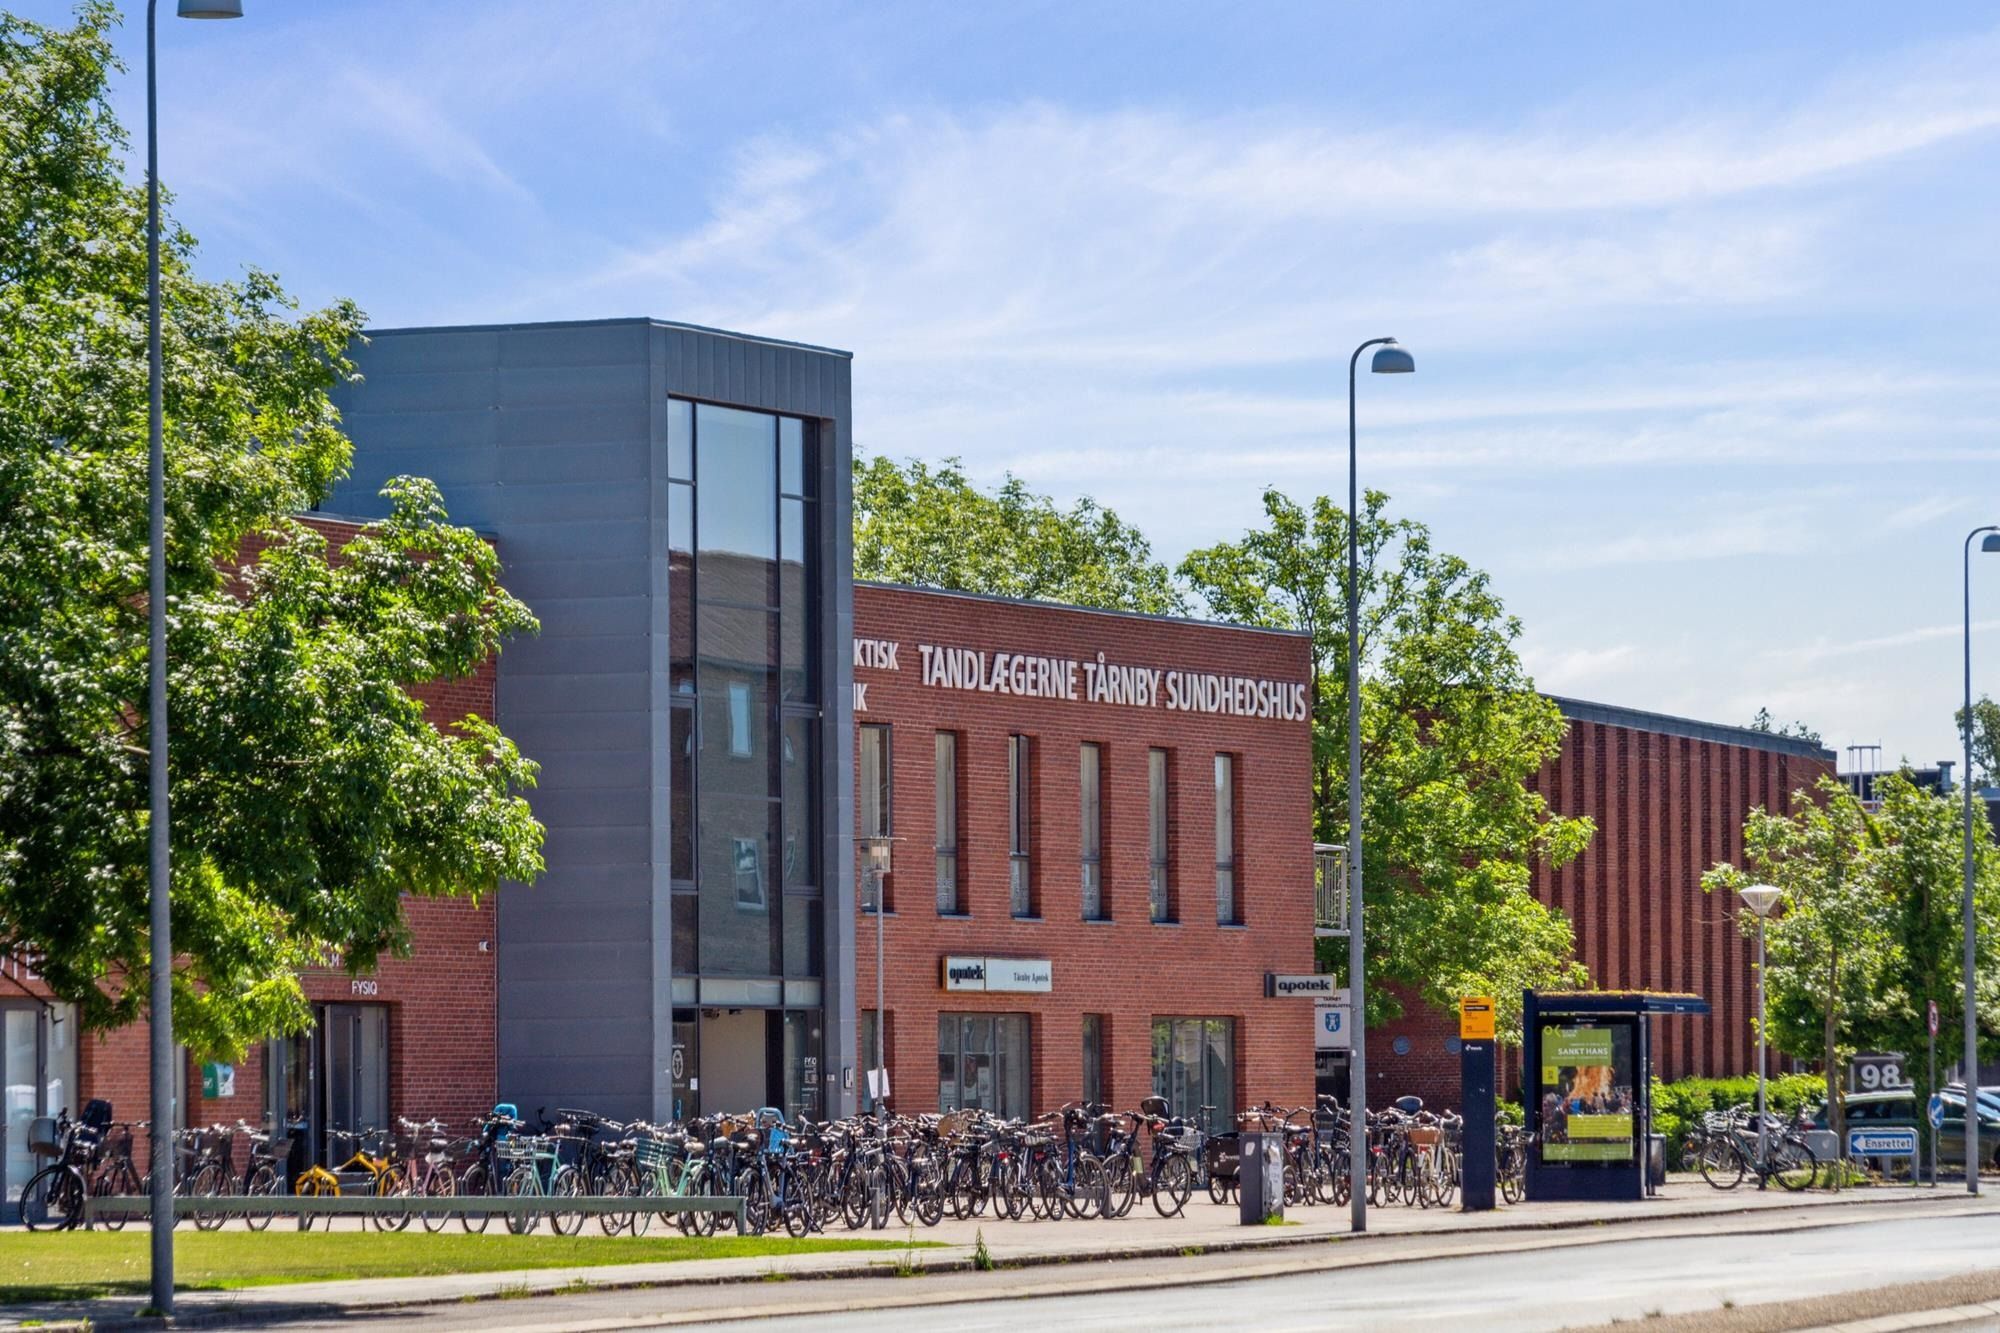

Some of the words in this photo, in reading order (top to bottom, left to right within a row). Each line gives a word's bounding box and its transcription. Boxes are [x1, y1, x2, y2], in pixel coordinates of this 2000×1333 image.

[917, 644, 1078, 700] TANDLÆGERNE
[1083, 650, 1161, 708] TÅRNBY
[1165, 671, 1307, 722] SUNDHEDSHUS
[1278, 980, 1330, 993] apotek
[1558, 1047, 1584, 1056] SANKT
[1585, 1047, 1609, 1056] HANS
[1860, 1063, 1900, 1089] 98
[1865, 1139, 1911, 1148] Ensrettet
